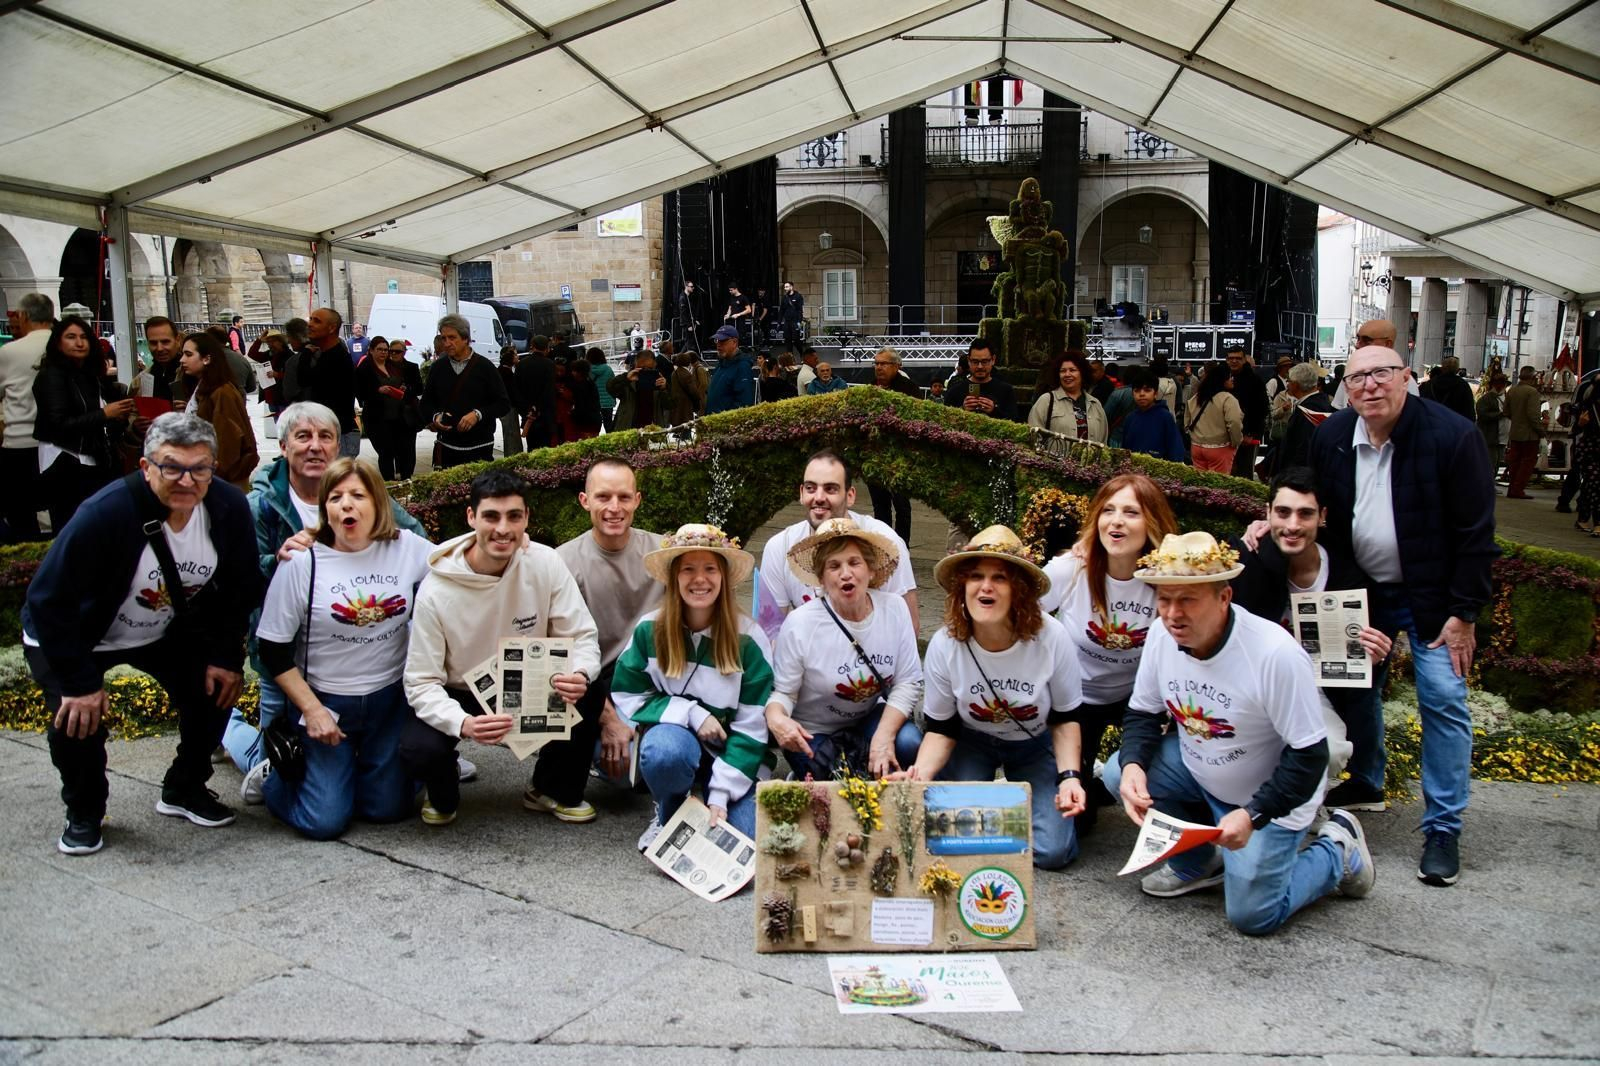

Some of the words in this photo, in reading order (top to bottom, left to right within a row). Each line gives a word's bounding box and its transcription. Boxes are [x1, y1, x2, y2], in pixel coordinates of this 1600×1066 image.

[330, 582, 347, 594] OS
[350, 573, 399, 587] LOLAILOS
[1110, 600, 1154, 618] LOLAILOS
[837, 662, 851, 675] OS
[854, 653, 894, 668] LOAILOS
[970, 681, 985, 694] OS
[989, 678, 1036, 696] OLAILOS
[1167, 680, 1180, 692] OS
[1185, 679, 1233, 709] LOLAILOS
[1206, 748, 1248, 766] CULTURAL
